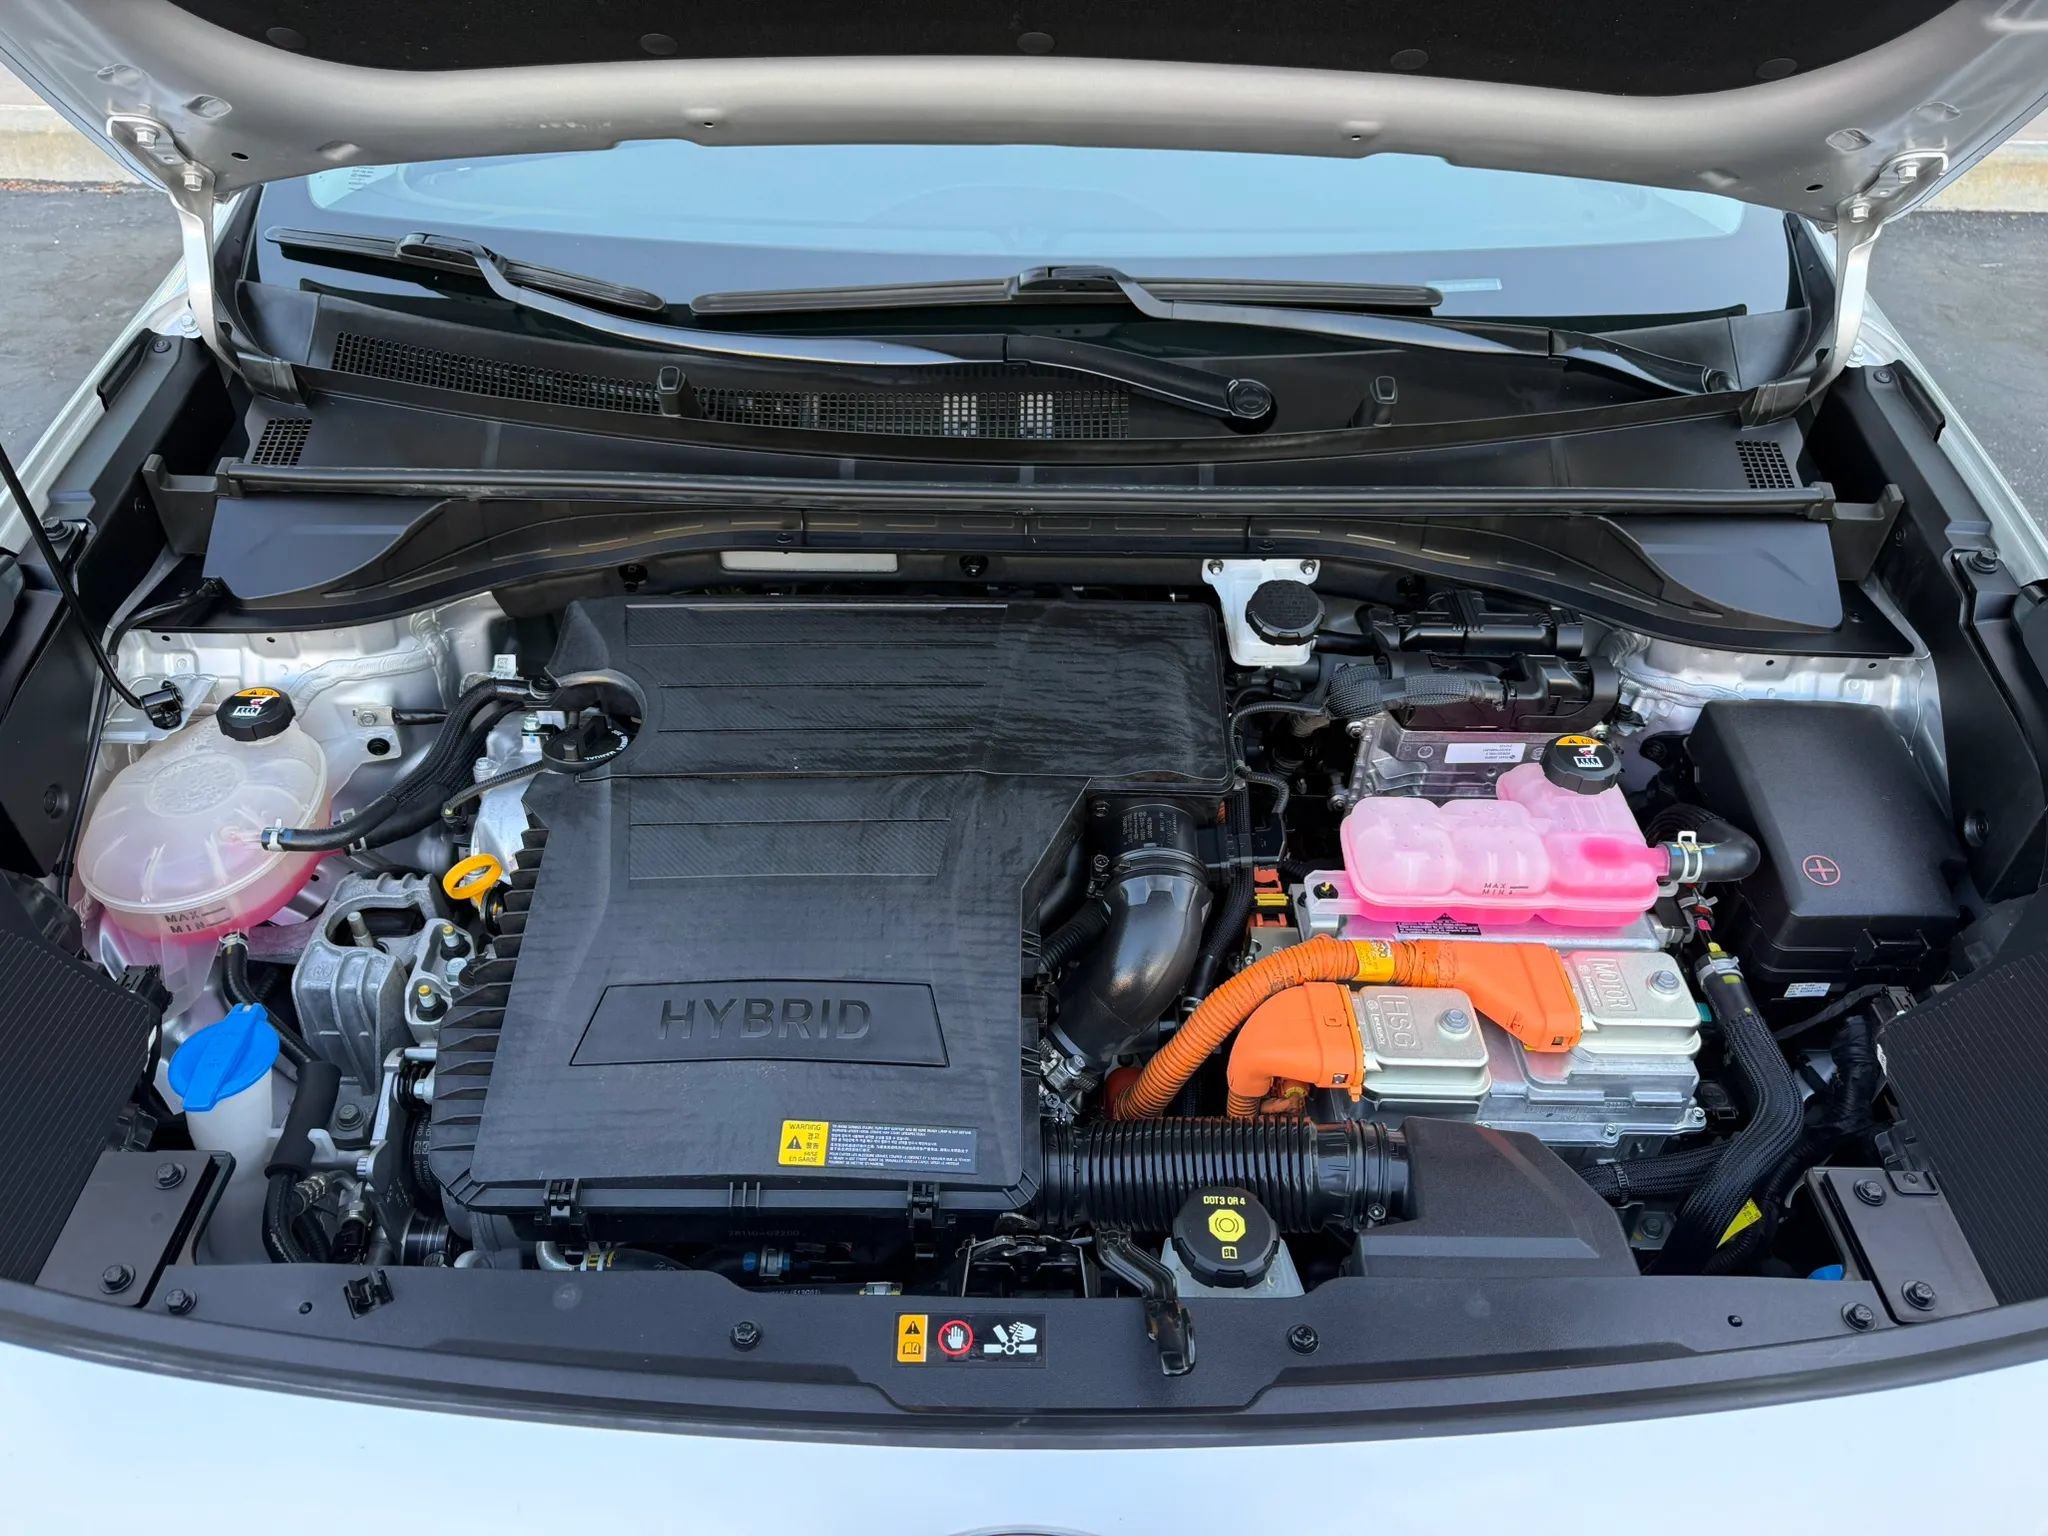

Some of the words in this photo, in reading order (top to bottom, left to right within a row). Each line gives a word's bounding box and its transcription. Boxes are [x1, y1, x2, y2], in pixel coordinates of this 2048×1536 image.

[164, 911, 199, 922] MAX
[170, 922, 205, 933] MIN
[1592, 963, 1630, 1008] MOTOR
[657, 998, 872, 1040] HYBRID
[1382, 1001, 1416, 1047] HSG
[789, 1123, 821, 1131] WARNING
[1227, 1196, 1239, 1206] OR
[1240, 1197, 1246, 1206] 4
